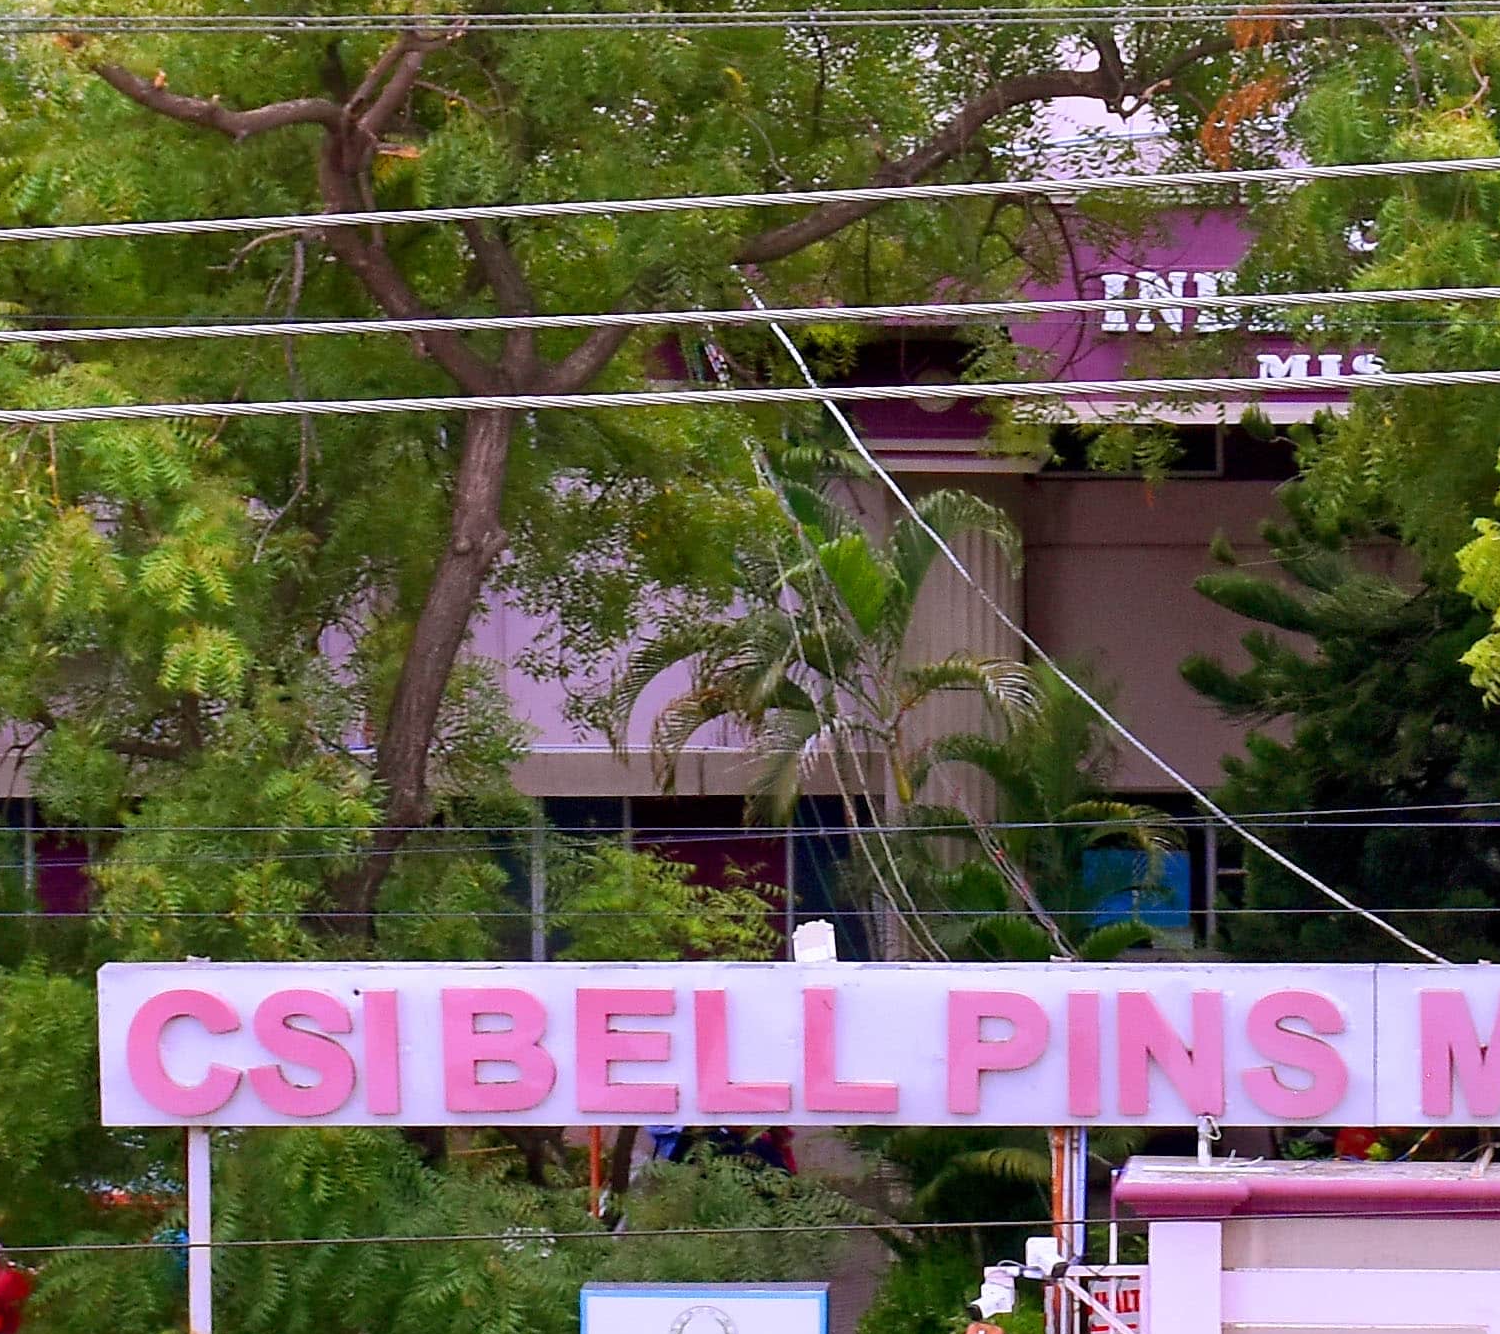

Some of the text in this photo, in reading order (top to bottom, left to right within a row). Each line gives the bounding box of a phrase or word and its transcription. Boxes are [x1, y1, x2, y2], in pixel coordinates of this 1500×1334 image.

[127, 987, 399, 1117] CSI
[442, 987, 899, 1113] BELL
[948, 989, 1350, 1119] PINS
